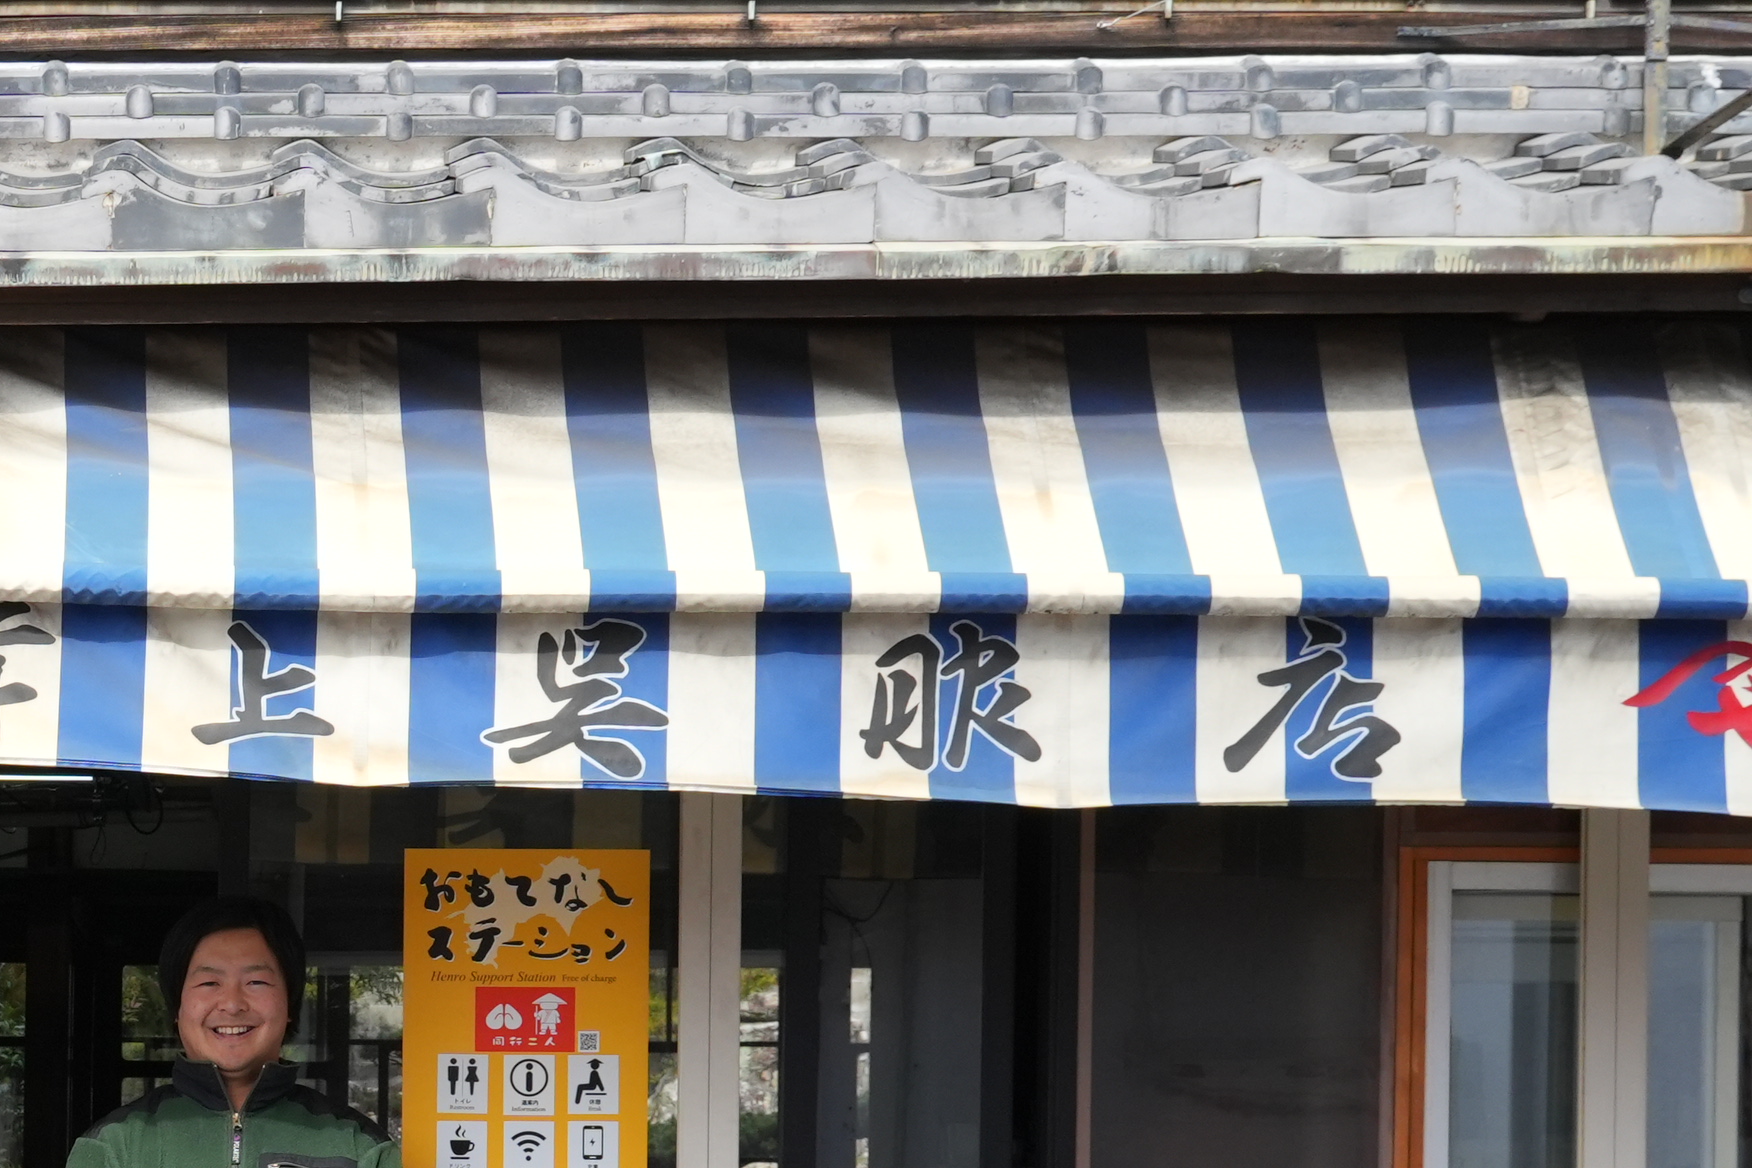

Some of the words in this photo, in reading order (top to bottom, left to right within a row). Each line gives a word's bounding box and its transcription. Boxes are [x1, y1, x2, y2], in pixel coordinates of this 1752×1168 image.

[427, 917, 628, 964] ステーション
[431, 970, 466, 983] Henro
[470, 970, 514, 985] Support
[517, 970, 557, 983] Station
[562, 973, 580, 983] Free
[581, 973, 590, 983] of
[591, 973, 617, 985] charge
